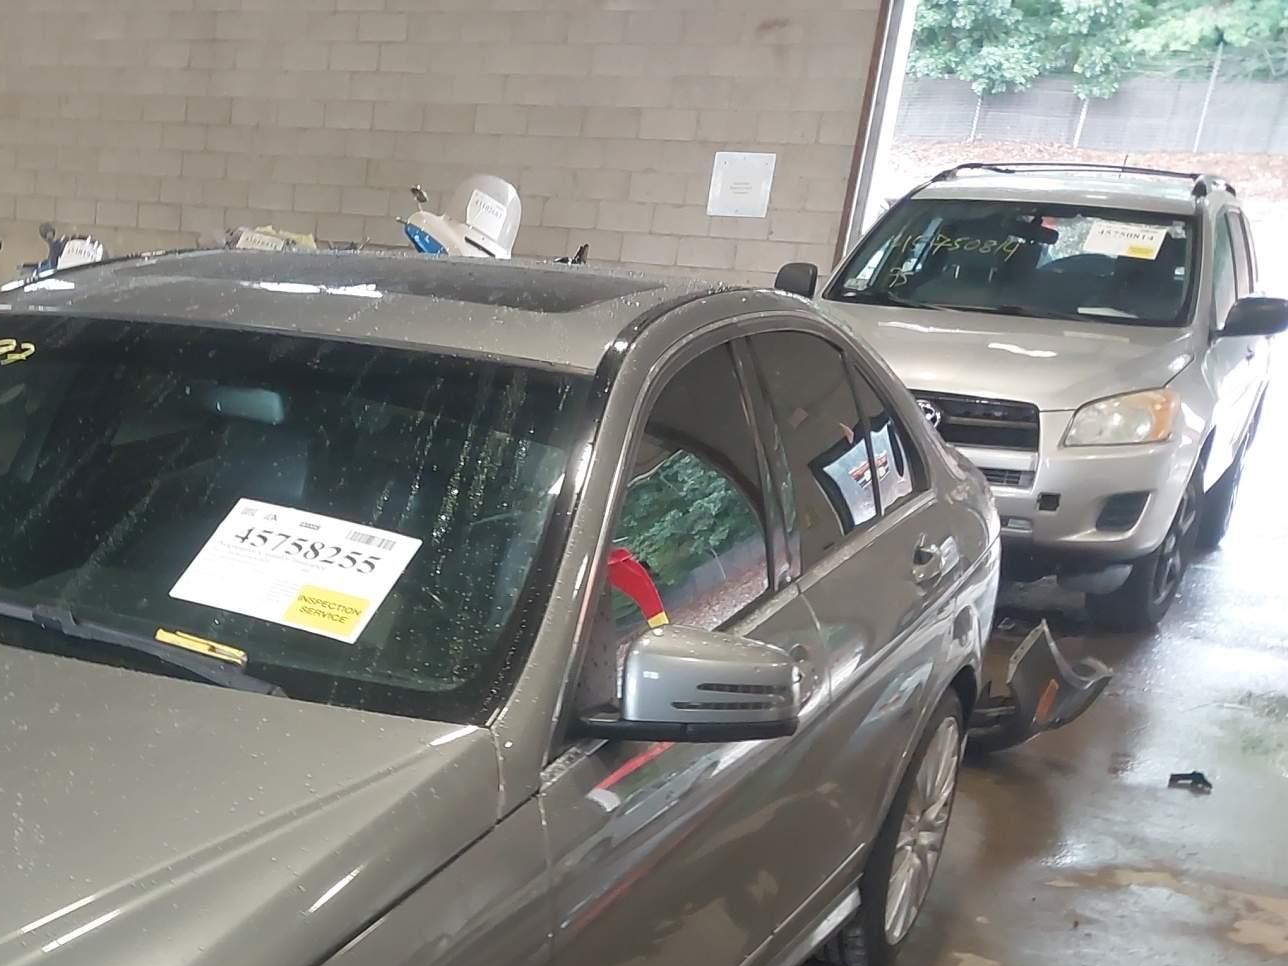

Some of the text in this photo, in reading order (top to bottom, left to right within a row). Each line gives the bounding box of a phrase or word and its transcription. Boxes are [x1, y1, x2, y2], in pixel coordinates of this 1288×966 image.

[235, 527, 381, 575] 45758255
[297, 594, 362, 618] INSPECTION
[298, 605, 351, 625] SERVICE
